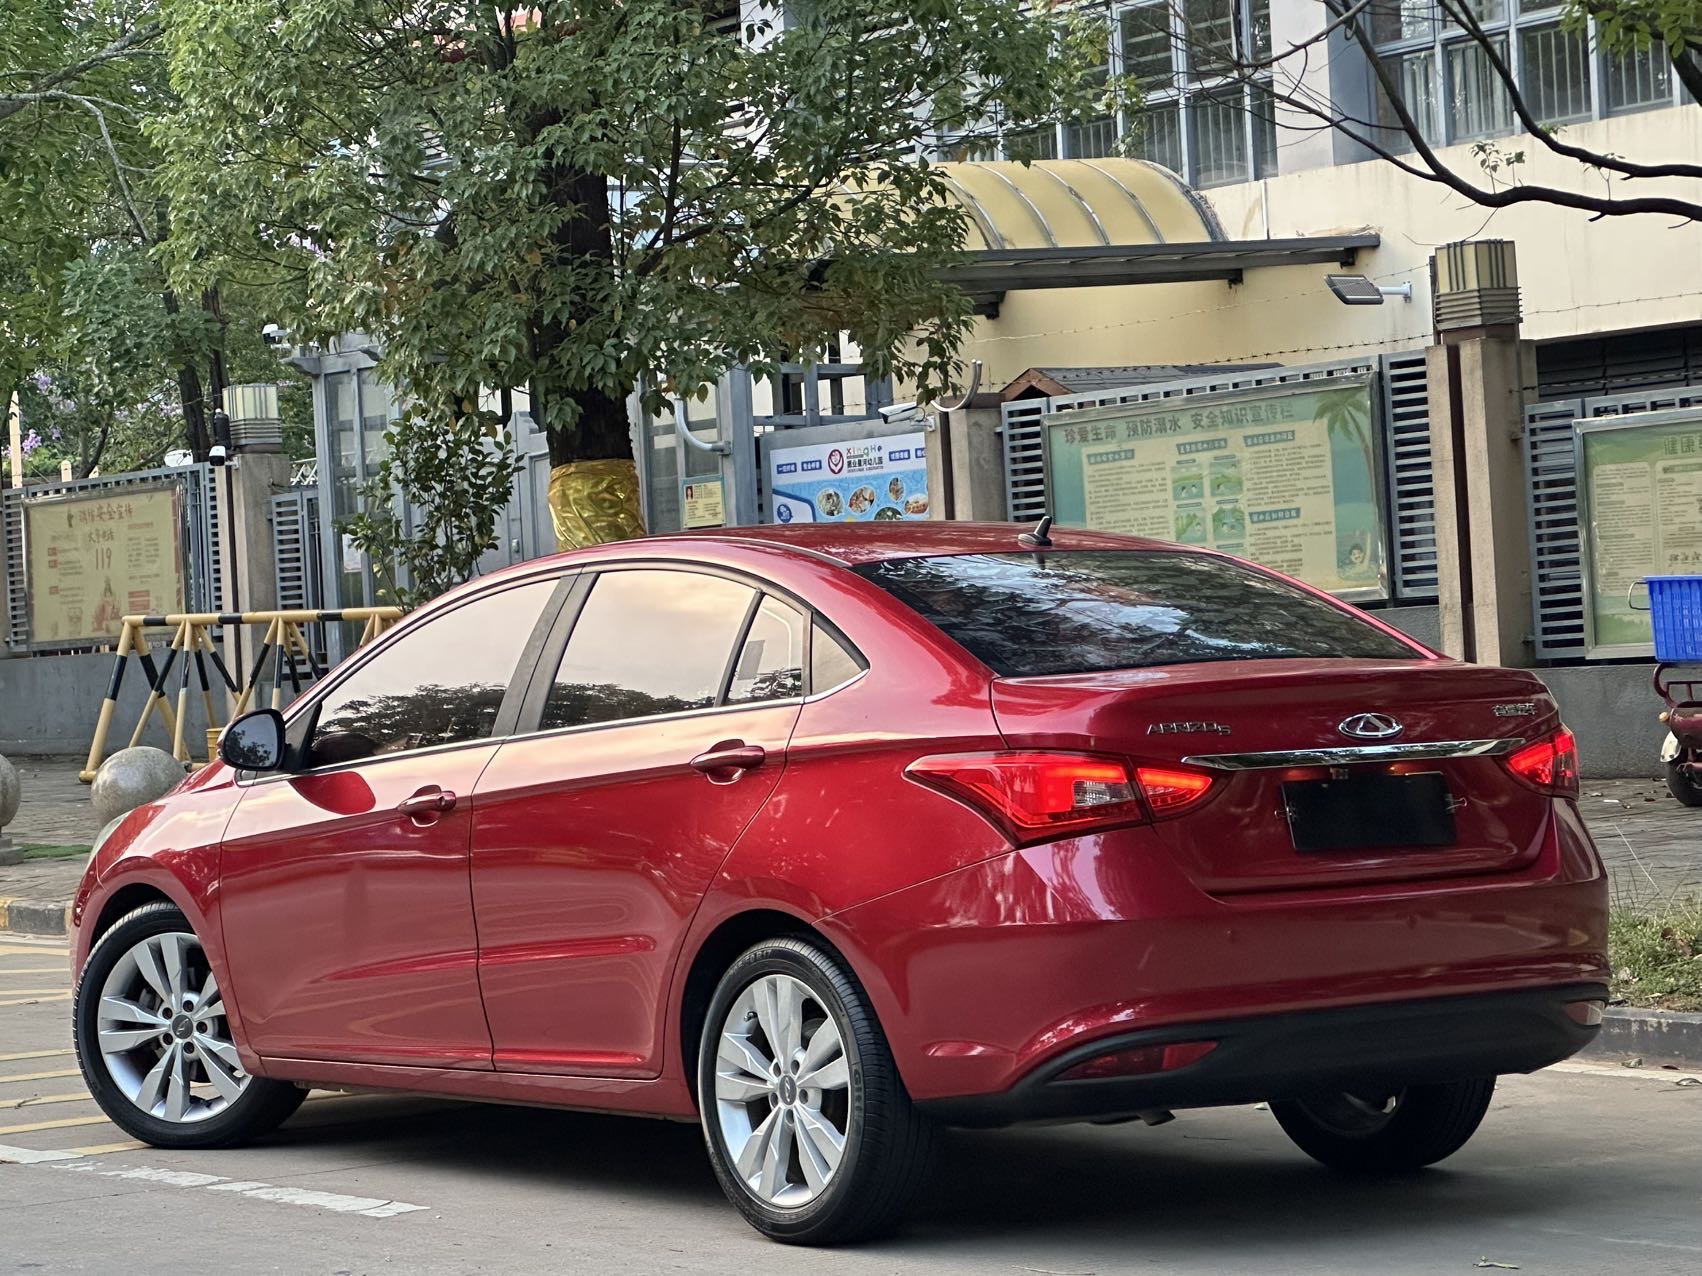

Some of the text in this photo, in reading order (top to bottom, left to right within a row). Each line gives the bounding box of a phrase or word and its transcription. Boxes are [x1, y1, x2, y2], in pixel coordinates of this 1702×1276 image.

[1064, 424, 1117, 444] 珍爱生命
[1125, 415, 1182, 438] 预防溺水
[1663, 433, 1702, 455] 健康
[96, 547, 112, 569] 119
